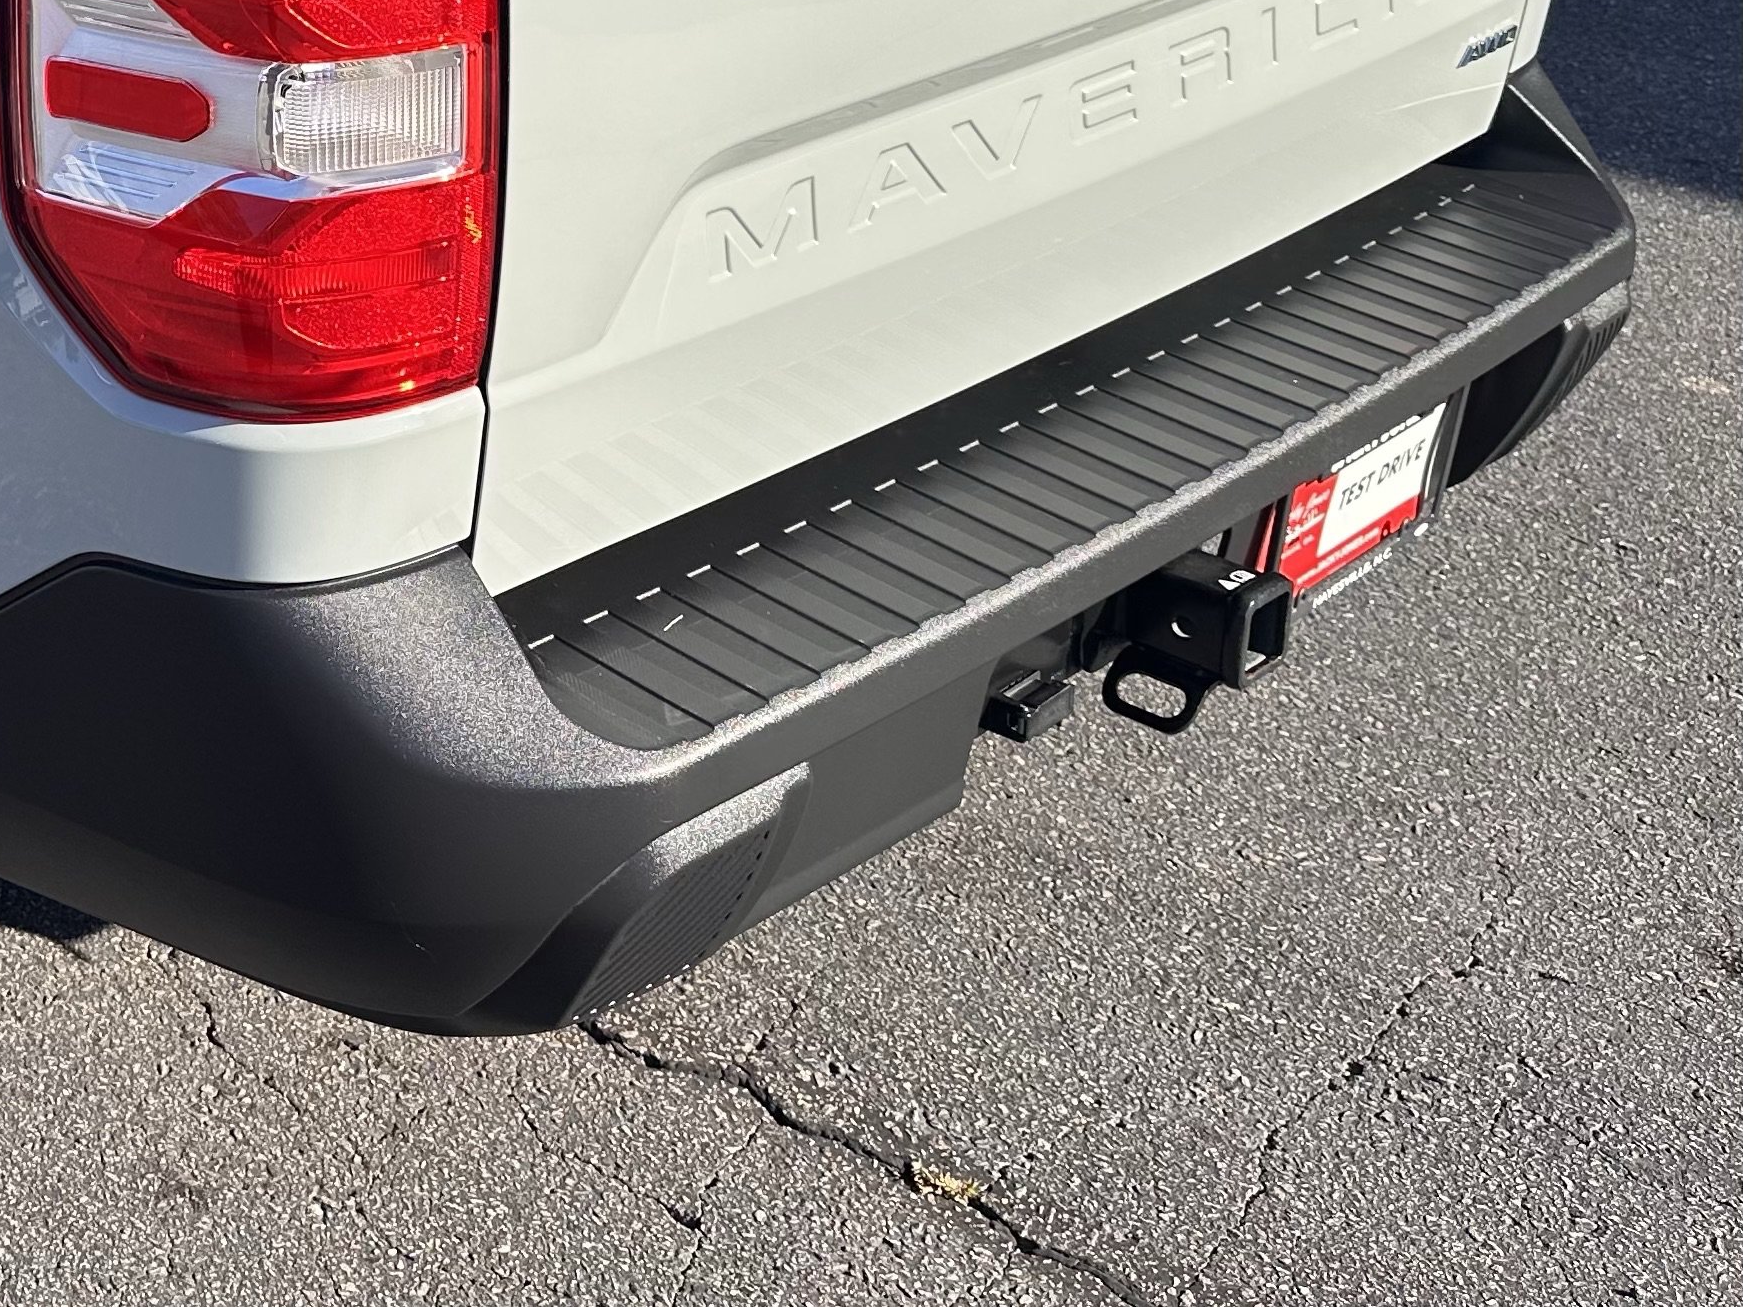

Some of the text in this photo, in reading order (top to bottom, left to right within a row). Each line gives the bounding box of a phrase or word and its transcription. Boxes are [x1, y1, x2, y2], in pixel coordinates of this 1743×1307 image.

[1455, 24, 1518, 70] AWD
[1337, 469, 1377, 511] TEST
[1376, 438, 1426, 486] DRIVE
